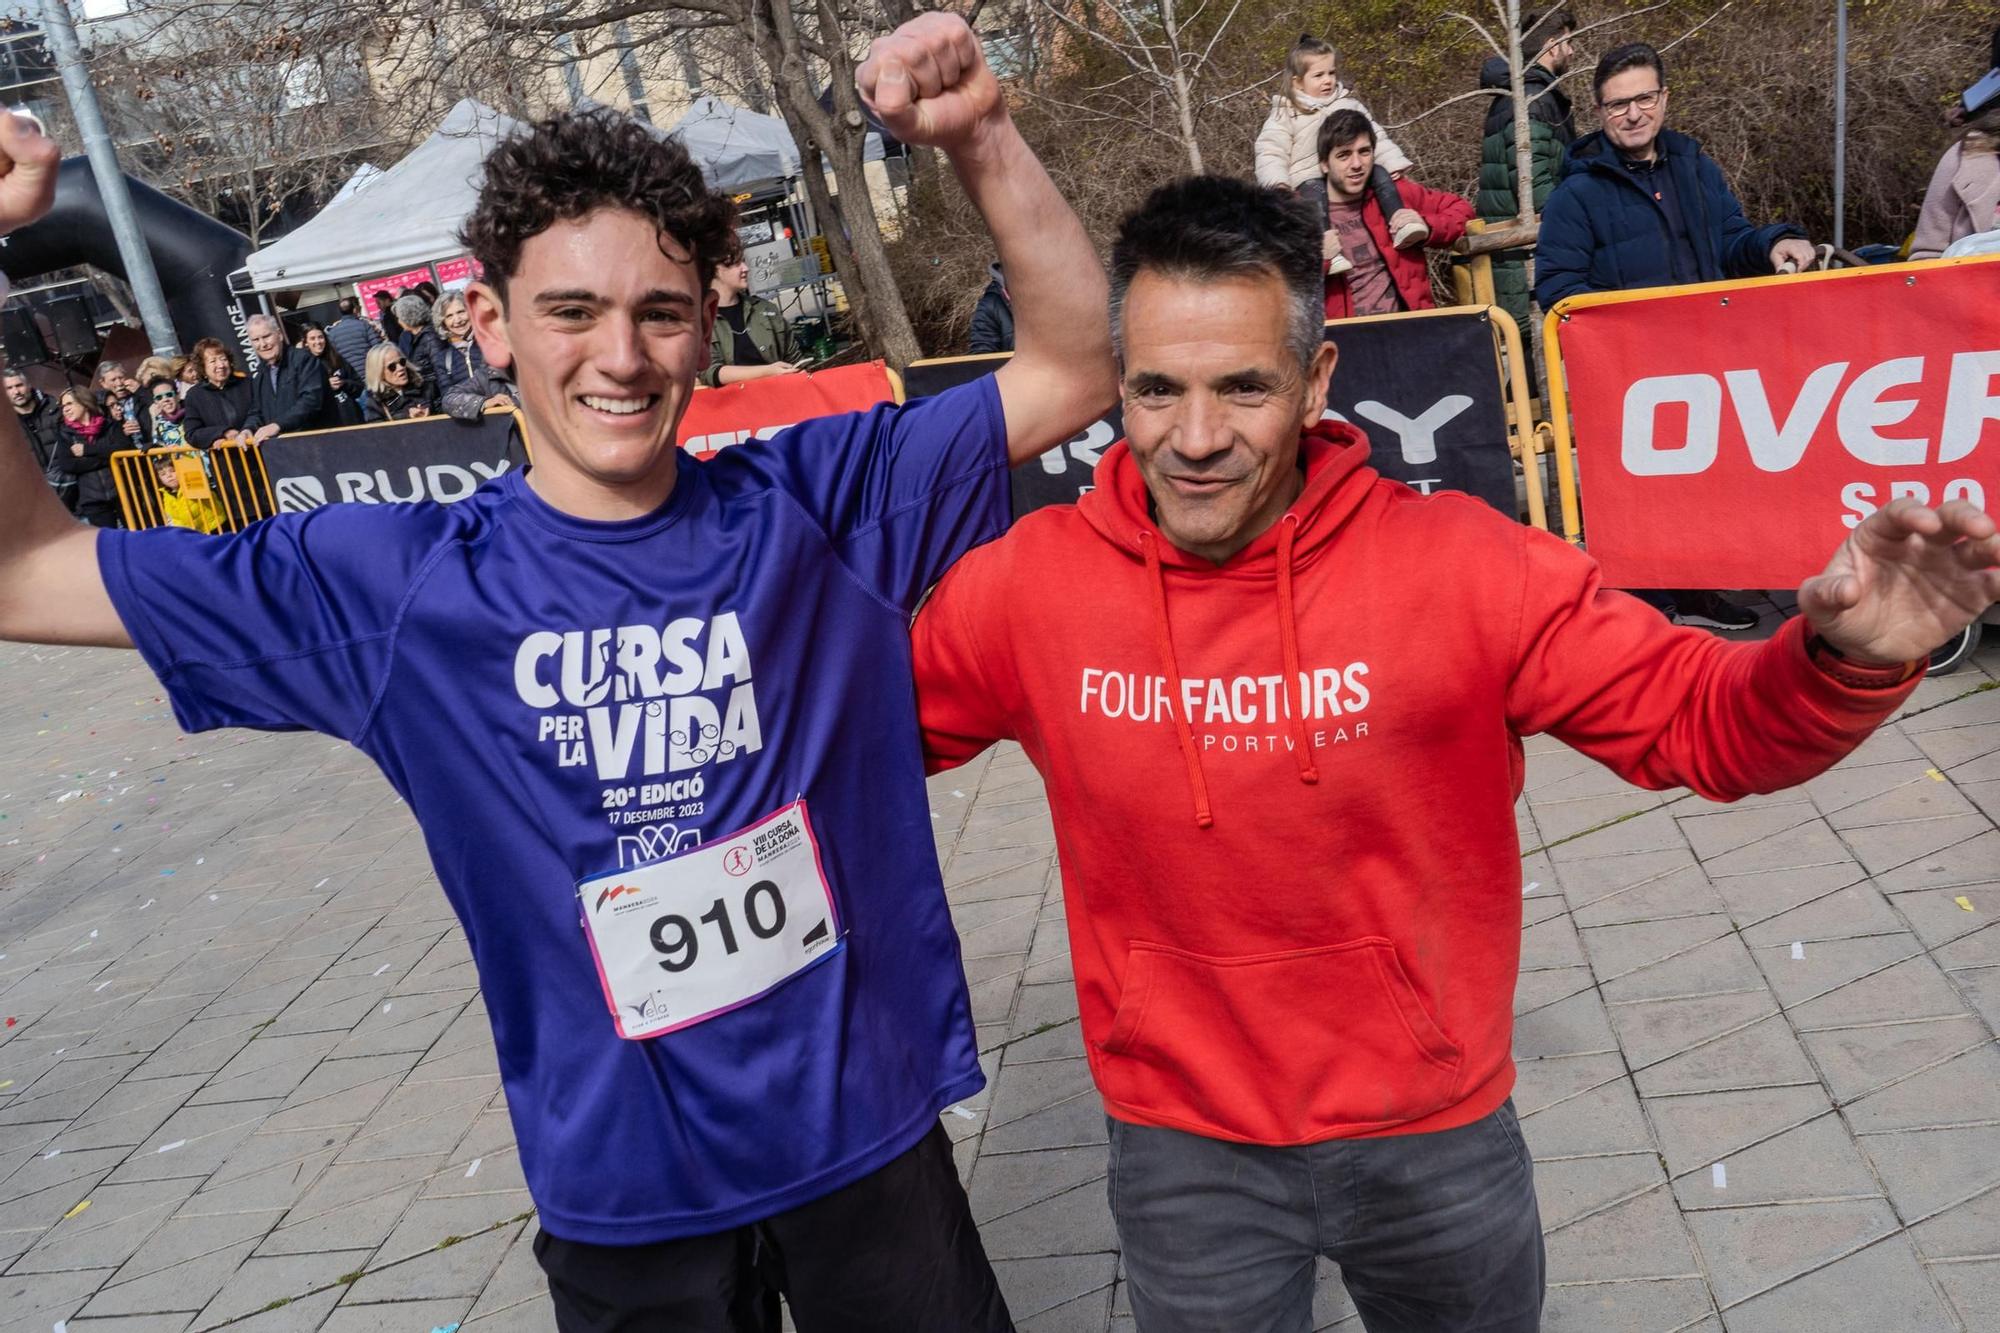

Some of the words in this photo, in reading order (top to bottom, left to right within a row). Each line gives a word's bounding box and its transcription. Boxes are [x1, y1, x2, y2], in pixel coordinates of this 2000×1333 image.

[514, 611, 752, 708] CURSA
[538, 715, 584, 742] PER
[586, 682, 763, 780] VIDA
[558, 741, 588, 767] LA
[640, 772, 704, 806] EDICIÓ
[608, 811, 620, 824] 17
[623, 806, 675, 824] DESEMBRE
[678, 802, 704, 817] 2023
[755, 844, 767, 855] DE
[767, 839, 778, 849] LA
[778, 826, 800, 843] DONA
[767, 820, 793, 839] CURSA
[650, 880, 787, 972] 910
